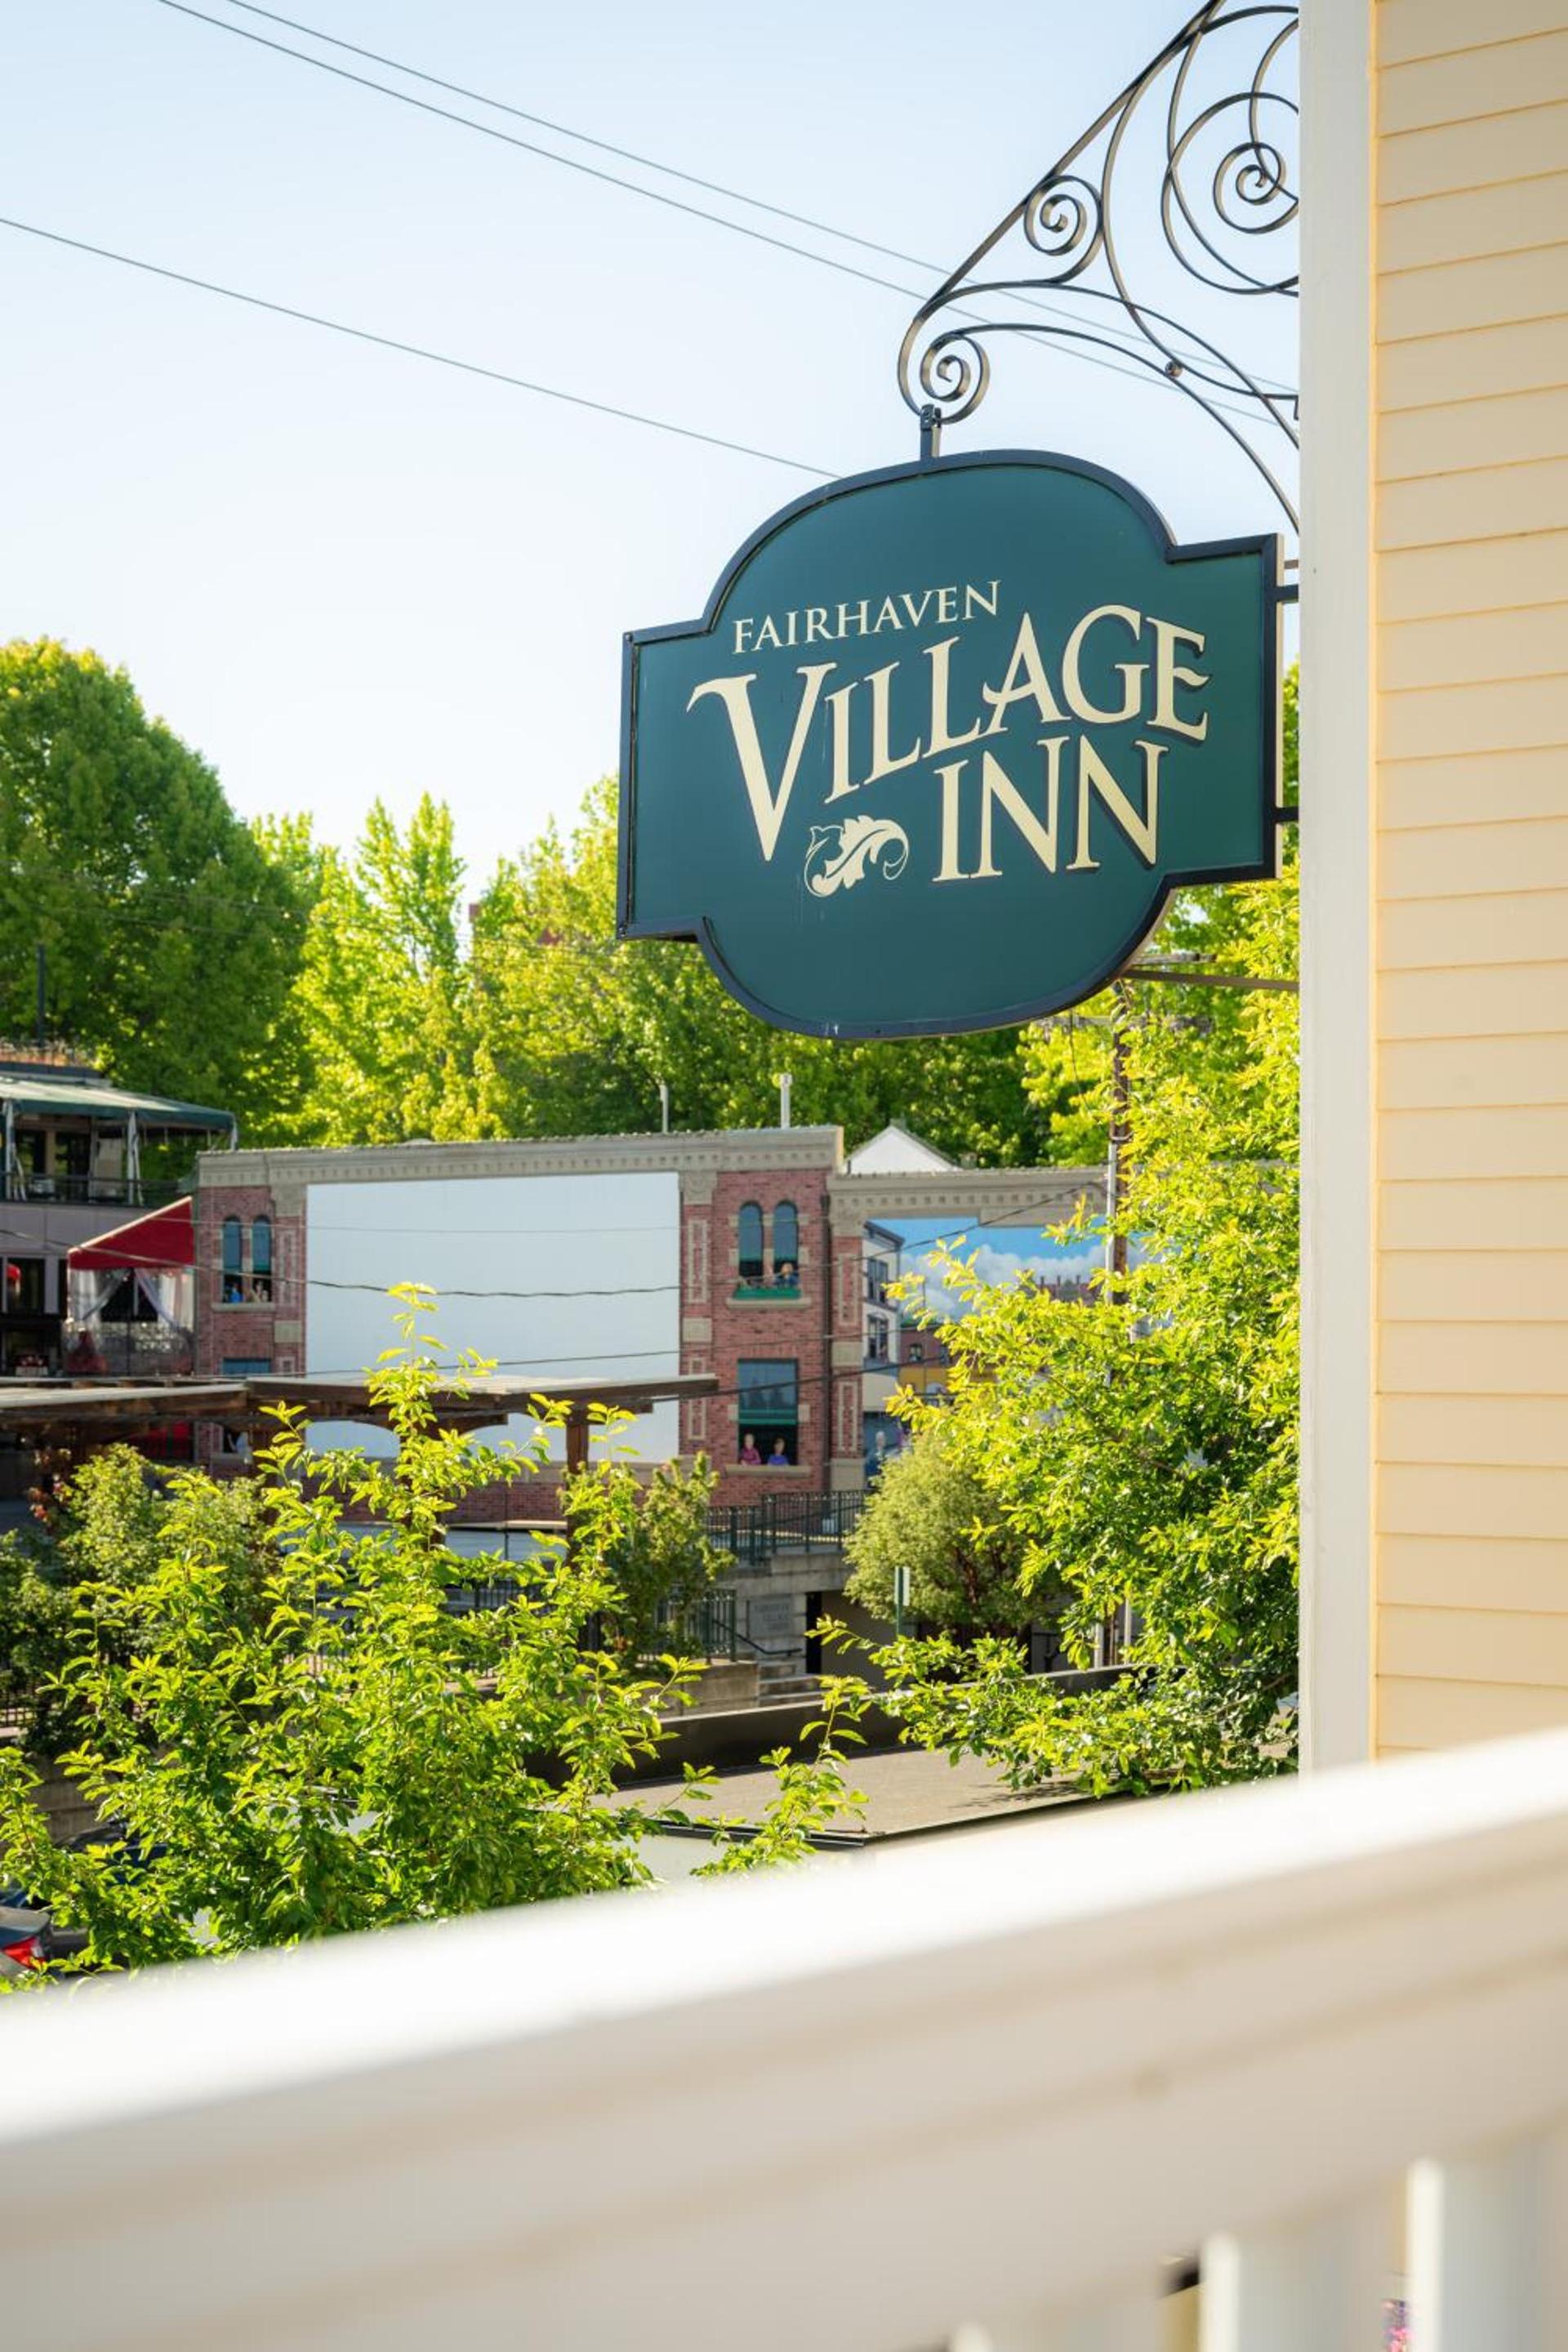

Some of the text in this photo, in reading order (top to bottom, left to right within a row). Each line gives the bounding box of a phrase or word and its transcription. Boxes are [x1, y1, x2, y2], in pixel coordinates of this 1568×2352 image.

[733, 581, 999, 653] FAIRHAVEN
[686, 605, 1209, 862] VILLAGE
[933, 735, 1169, 882] INN
